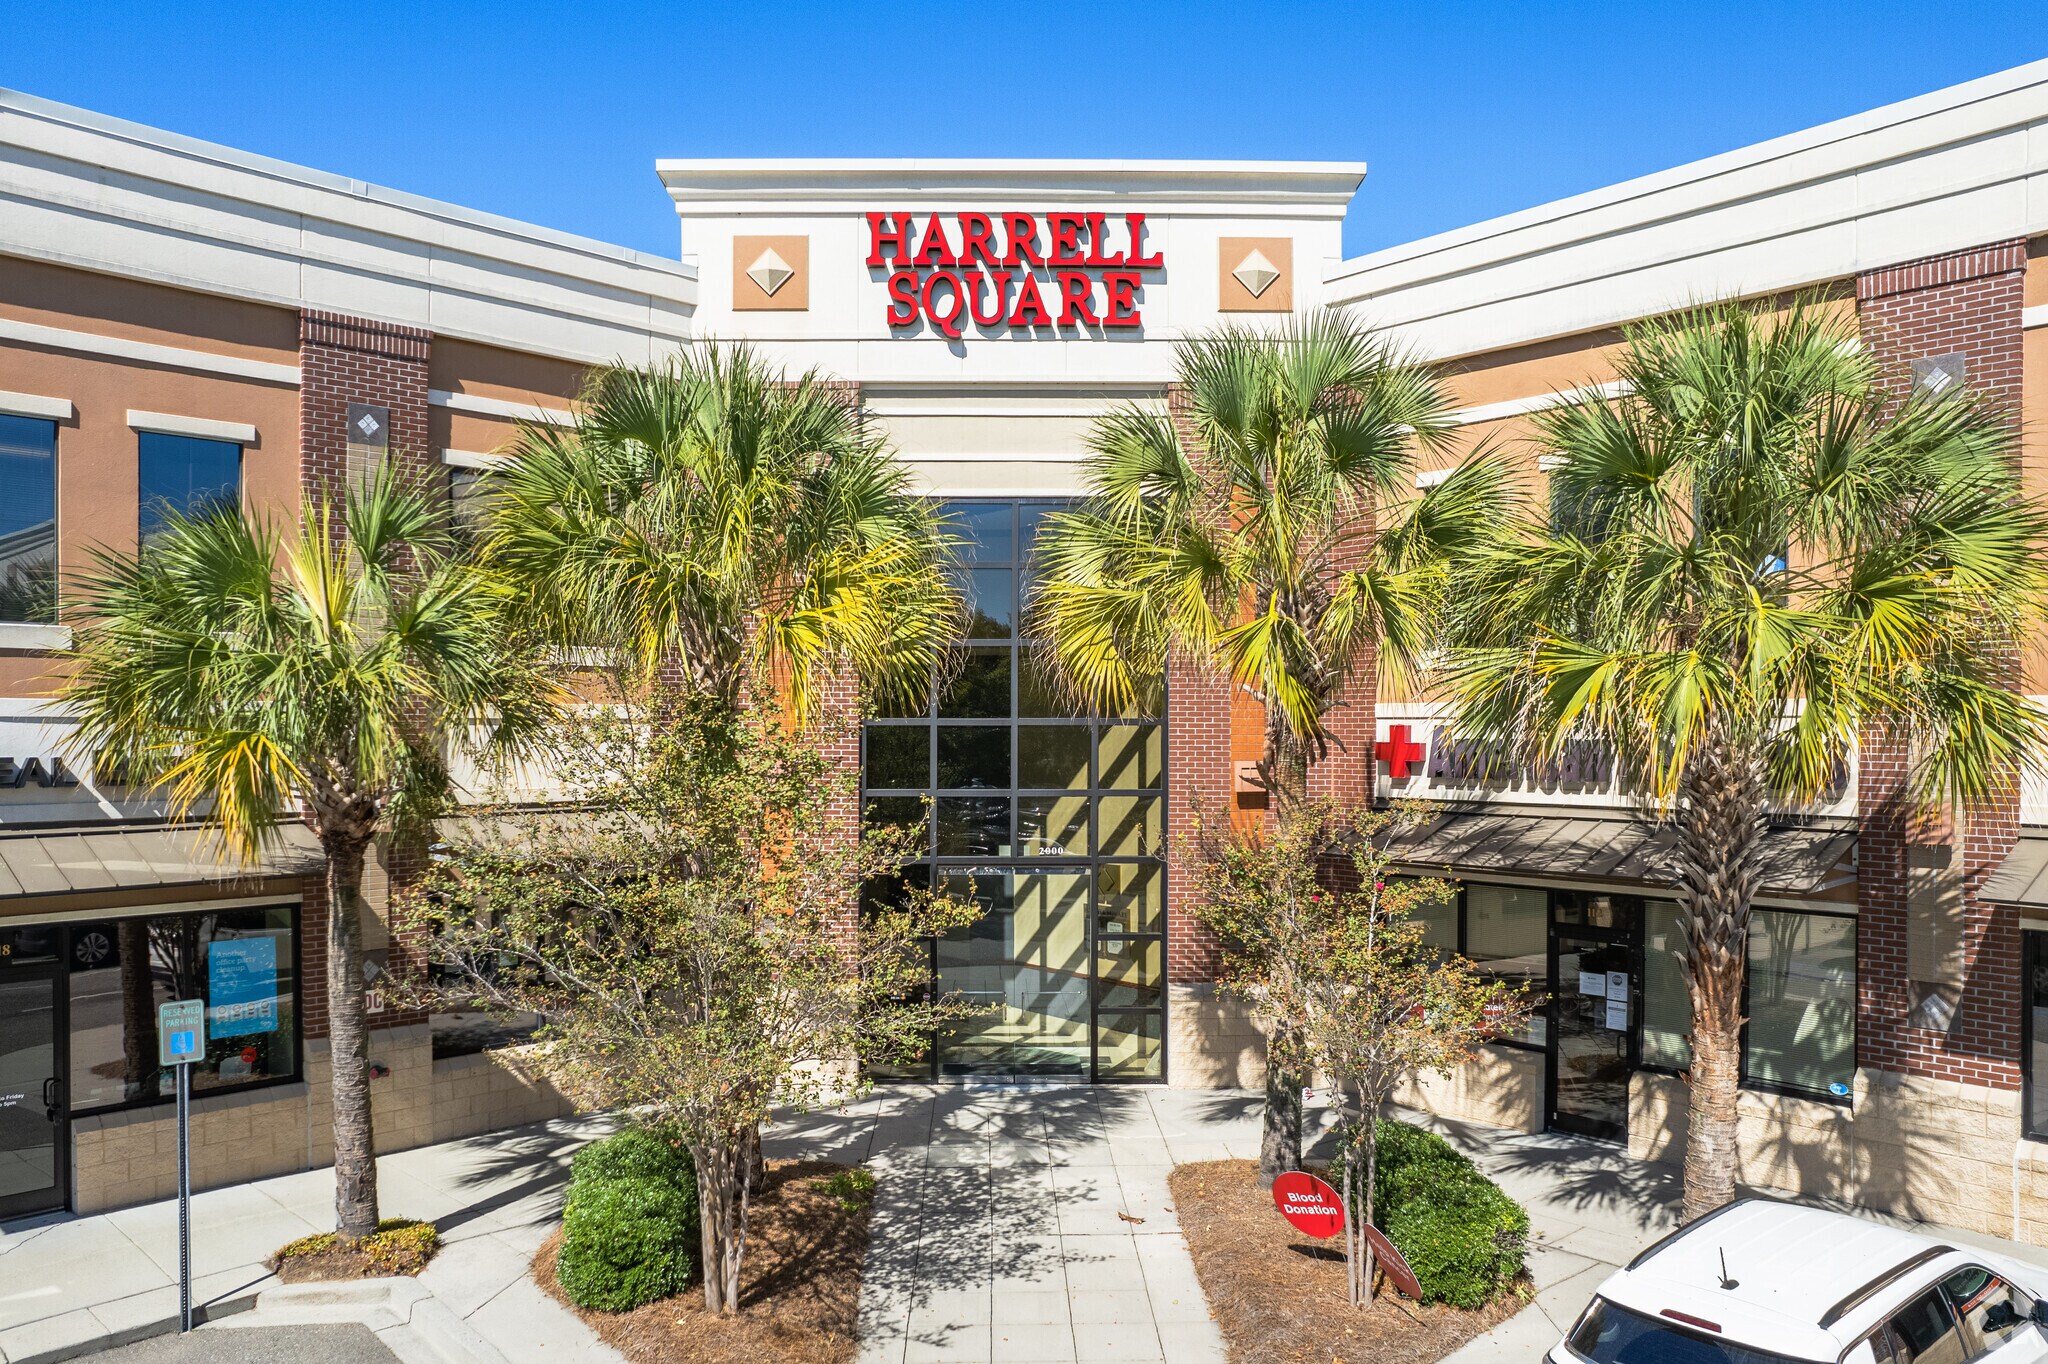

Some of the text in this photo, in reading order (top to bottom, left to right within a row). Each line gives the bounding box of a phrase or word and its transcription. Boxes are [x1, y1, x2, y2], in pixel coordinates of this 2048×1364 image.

[866, 212, 1163, 268] HARRELL
[887, 271, 1141, 339] SQUARE
[1038, 846, 1064, 855] 2000
[216, 950, 247, 958] Another
[237, 957, 257, 966] party
[163, 1006, 200, 1018] RESERVED
[166, 1017, 199, 1028] PARKING
[1287, 1192, 1324, 1203] Blood
[1283, 1204, 1338, 1216] Donation
